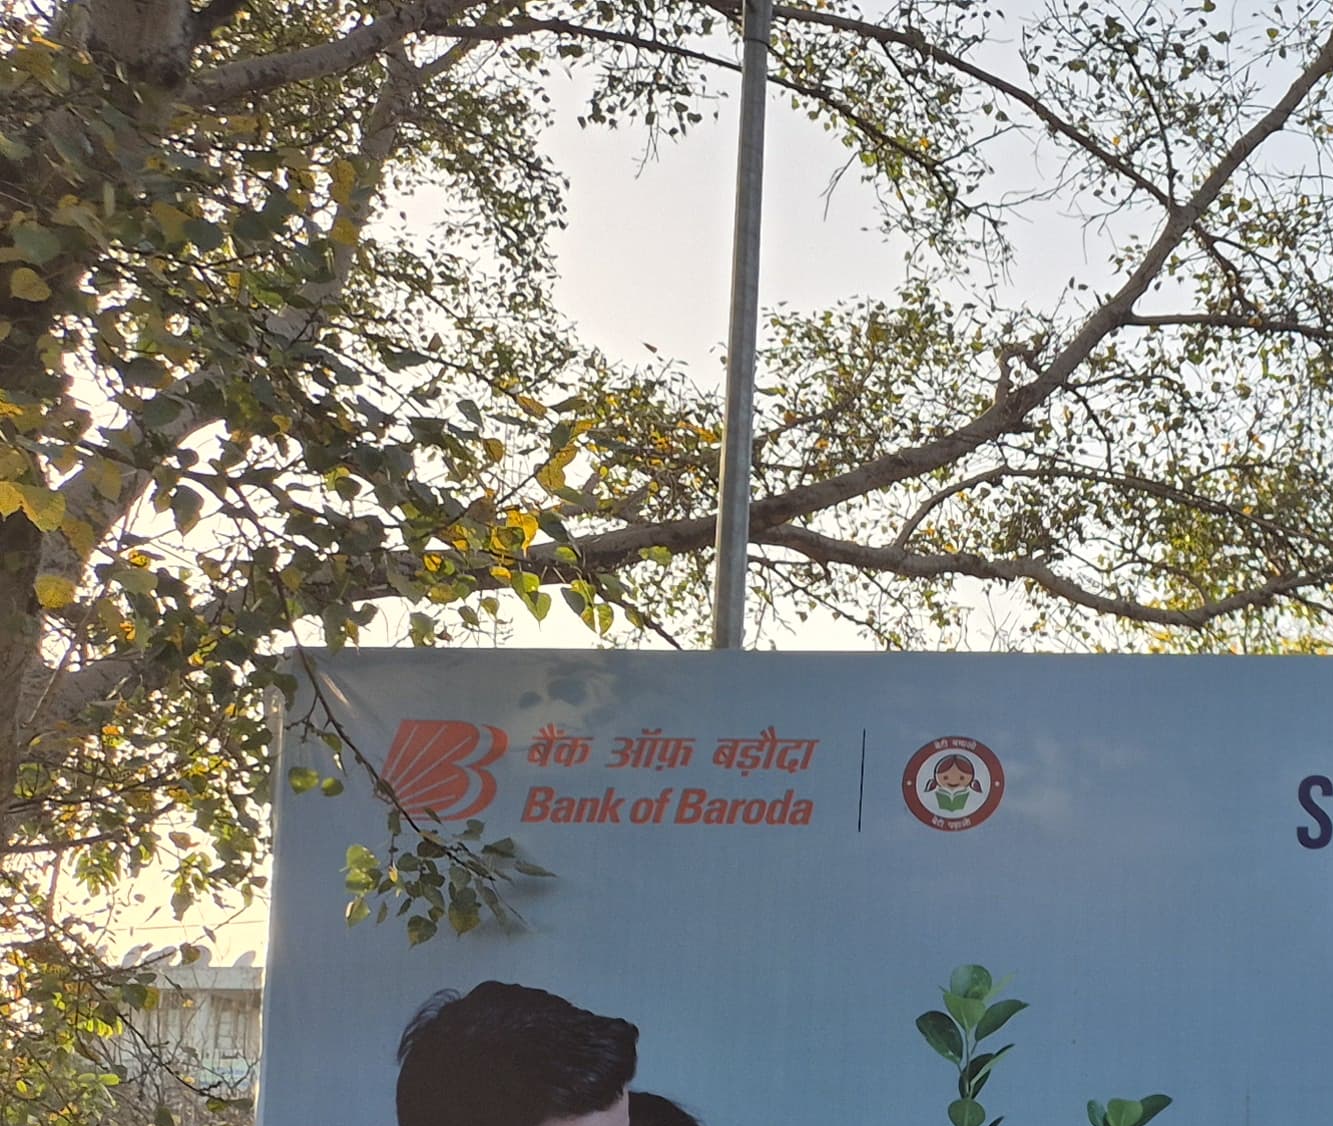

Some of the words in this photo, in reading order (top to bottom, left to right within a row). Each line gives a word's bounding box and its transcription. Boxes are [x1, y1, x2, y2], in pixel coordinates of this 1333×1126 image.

[528, 721, 593, 767] बैंक
[520, 785, 621, 824] Bank
[629, 787, 671, 826] of
[677, 787, 814, 827] Baroda
